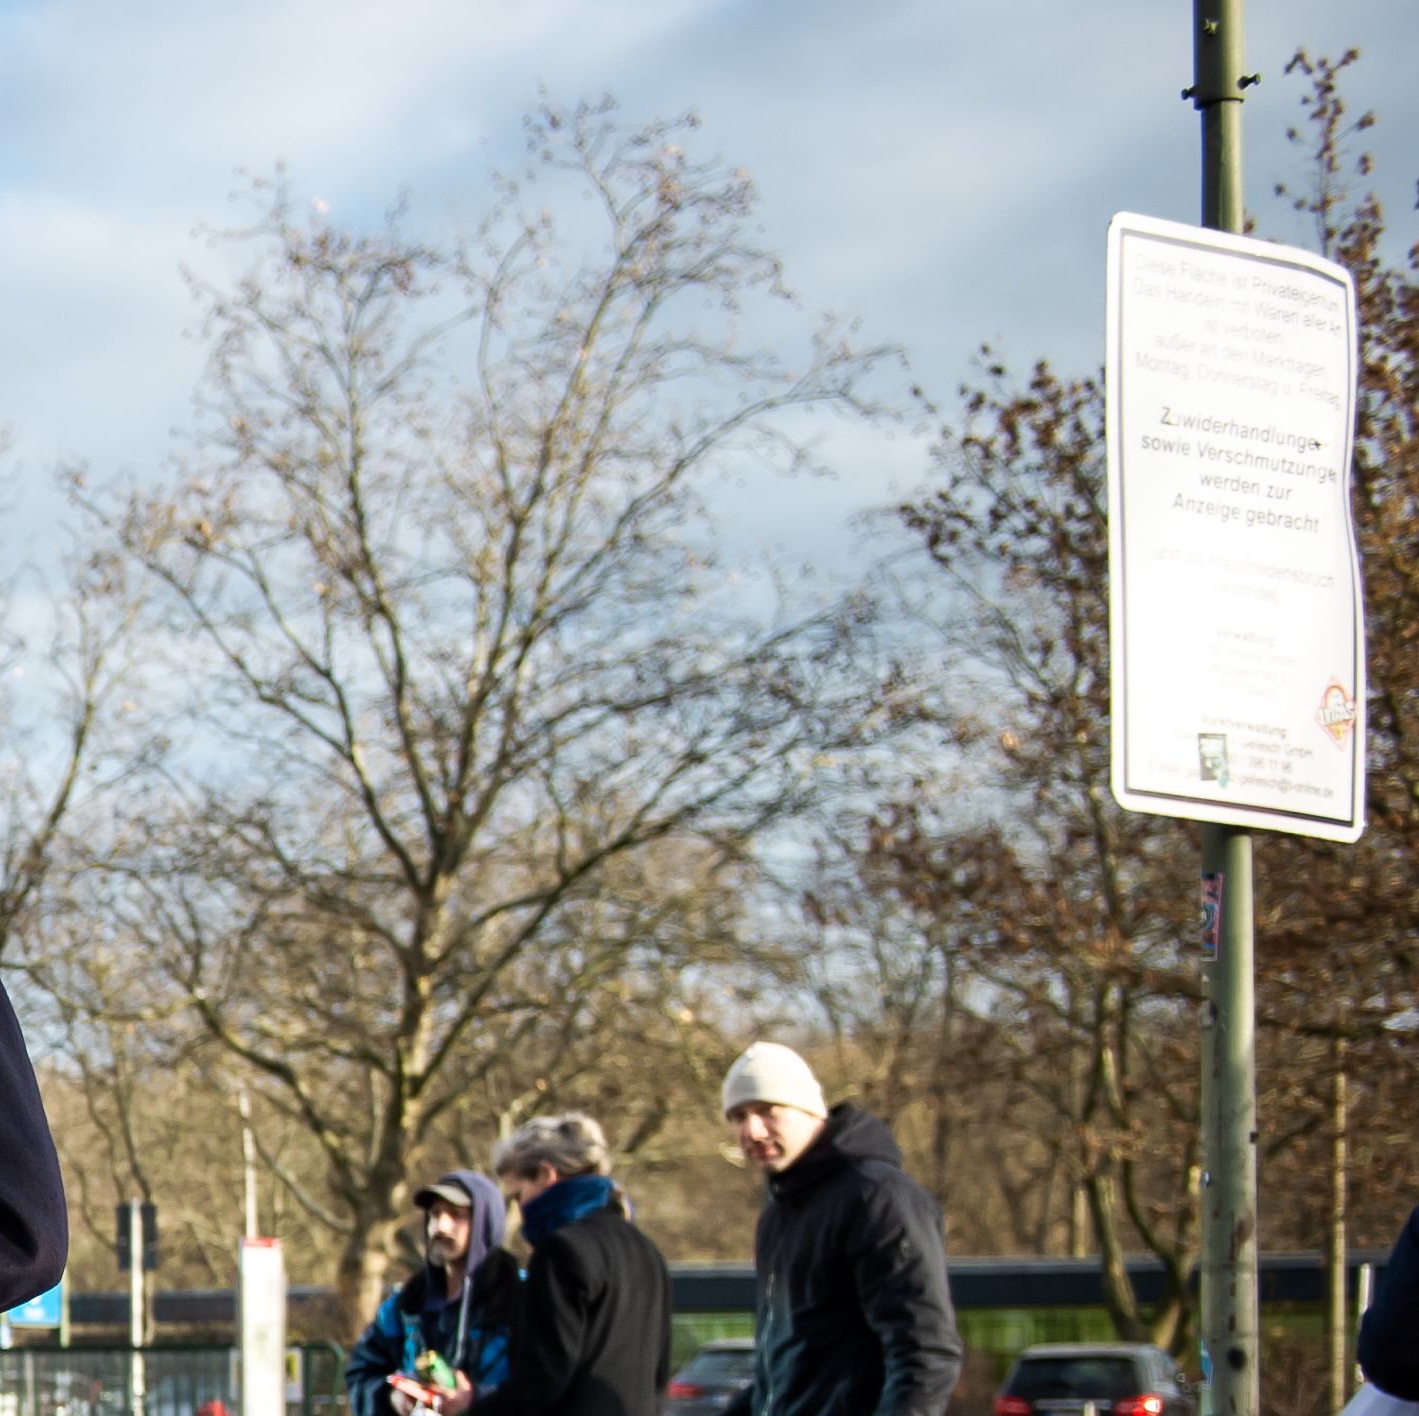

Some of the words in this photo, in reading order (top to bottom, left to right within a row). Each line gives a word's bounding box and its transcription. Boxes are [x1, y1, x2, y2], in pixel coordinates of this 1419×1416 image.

[1135, 253, 1176, 277] Diese
[1180, 260, 1227, 287] Fläche
[1231, 273, 1249, 291] ist
[1133, 276, 1161, 299] Das
[1165, 284, 1224, 311] Handeln
[1228, 297, 1250, 316] mit
[1254, 301, 1299, 325] Waren
[1202, 317, 1219, 334] ist
[1154, 332, 1195, 353] außer
[1200, 342, 1218, 357] an
[1221, 345, 1249, 363] den
[1197, 362, 1279, 398] Donnerstag
[1299, 380, 1342, 412] Freitag
[1141, 432, 1191, 457] sowie
[1159, 405, 1327, 455] Zuwiderhandlunge
[1199, 471, 1260, 497] werden
[1266, 484, 1294, 502] zur
[1172, 491, 1241, 524] Anzeige
[1246, 508, 1320, 534] gebracht
